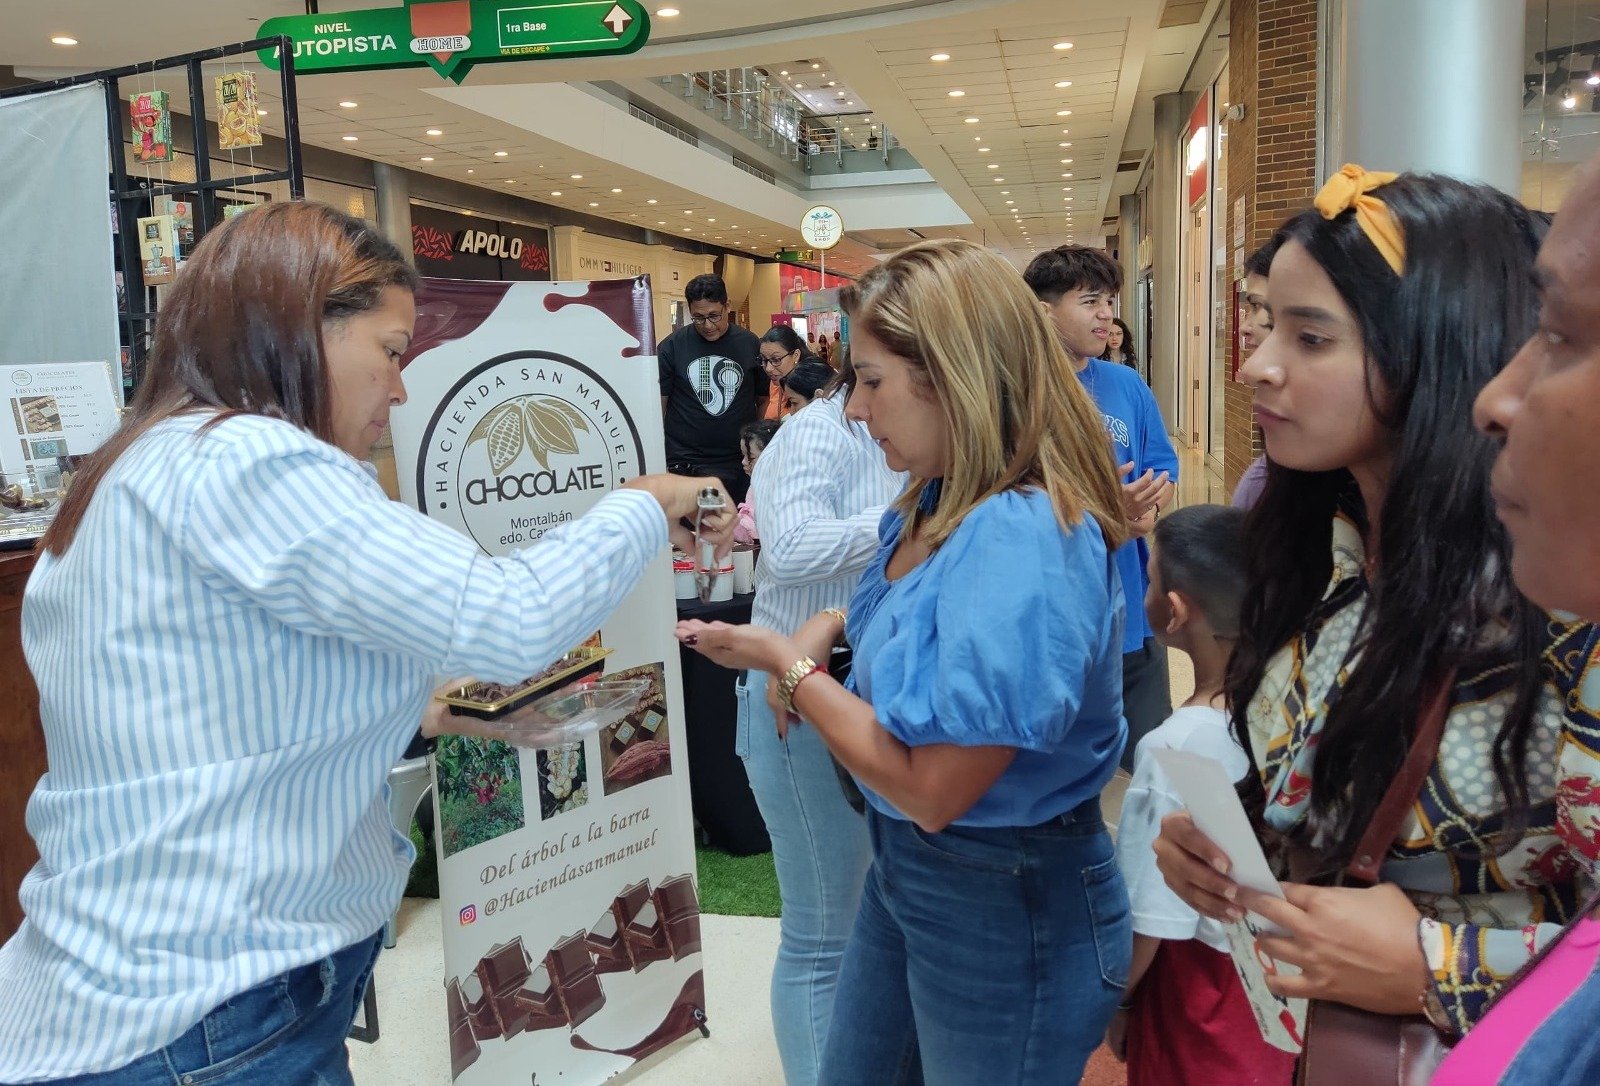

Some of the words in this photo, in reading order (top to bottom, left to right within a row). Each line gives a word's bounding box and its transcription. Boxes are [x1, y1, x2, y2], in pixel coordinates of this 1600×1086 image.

[314, 22, 351, 34] NIVEL
[505, 23, 521, 33] 1ra
[523, 21, 547, 32] Base
[417, 37, 463, 51] HOME
[460, 229, 522, 260] APOLO
[435, 375, 506, 492] HACIENDA
[520, 368, 563, 384] SAN
[576, 383, 627, 470] MANUEL
[465, 463, 604, 506] CHOCOLATE
[510, 510, 573, 530] Montalbán
[480, 854, 516, 886] Del
[521, 832, 567, 869] árbol
[571, 834, 582, 849] a
[587, 821, 604, 844] la
[609, 806, 651, 834] barra
[484, 828, 659, 917] @Haciendasanmanuel
